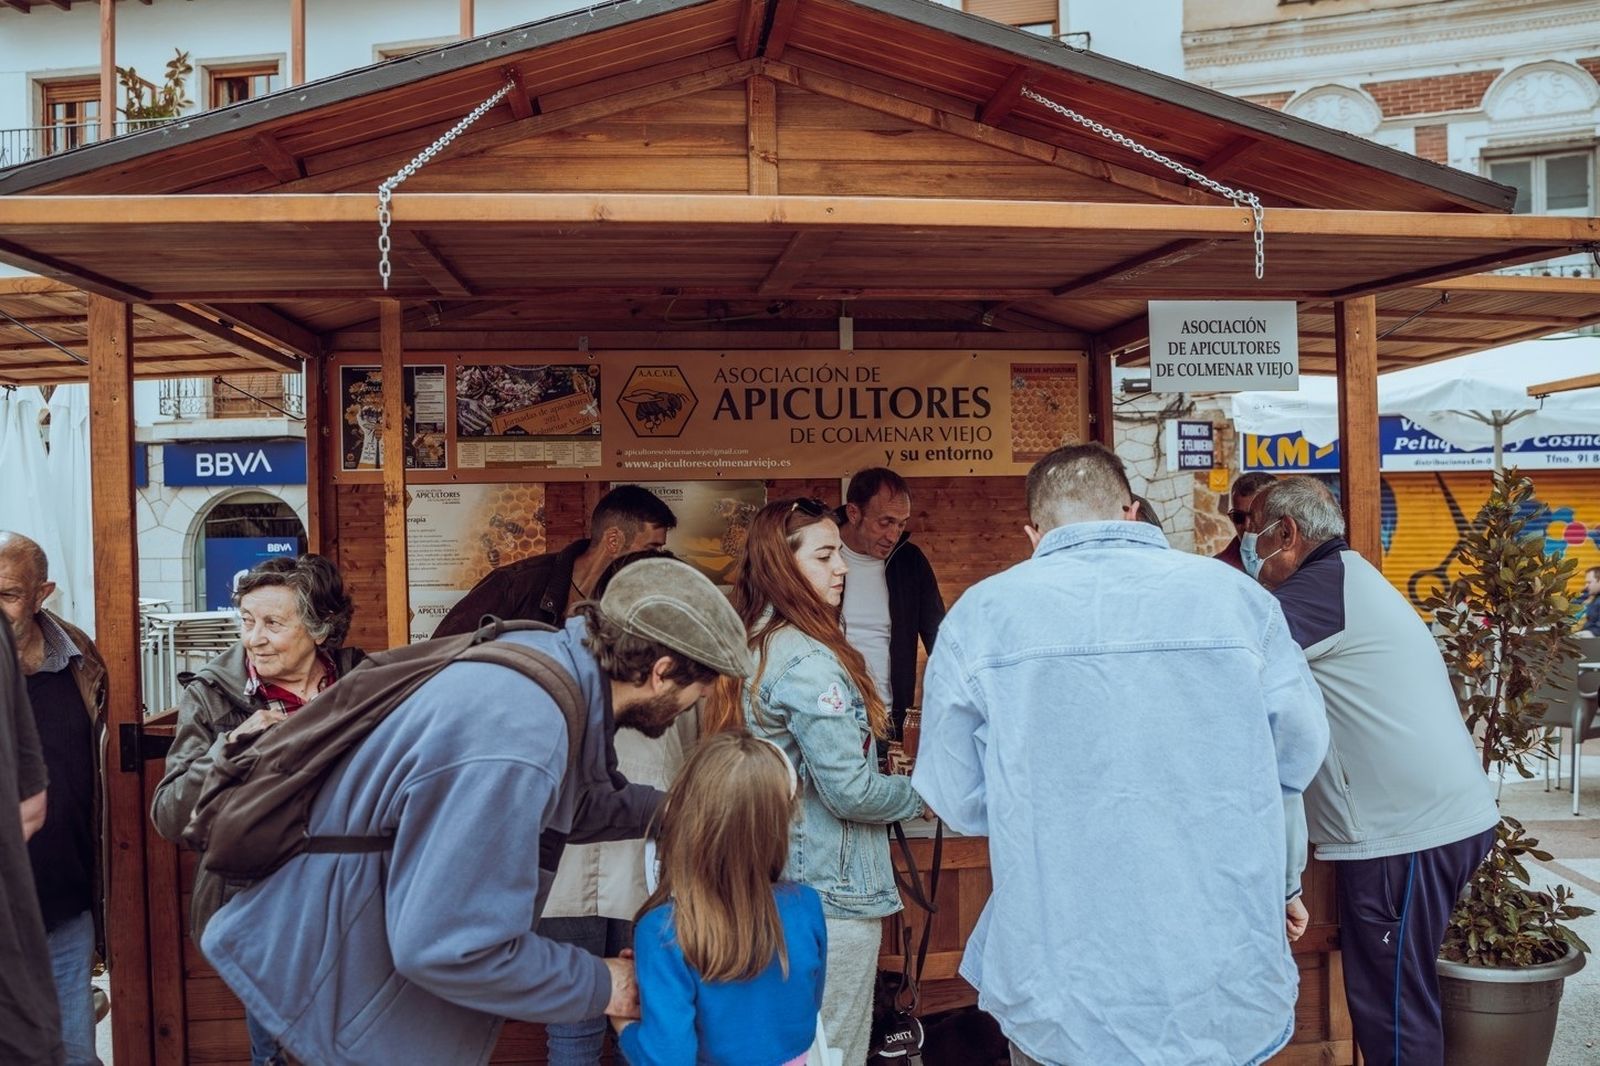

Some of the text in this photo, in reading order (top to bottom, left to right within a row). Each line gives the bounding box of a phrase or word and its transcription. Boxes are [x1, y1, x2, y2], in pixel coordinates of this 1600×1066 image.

[1181, 317, 1267, 334] ASOCIACIÓN
[1168, 341, 1281, 356] DE APICULTORES
[713, 363, 881, 384] ASOCIACIÓN DE
[1156, 361, 1294, 379] DE COLMENAR VIEJO
[712, 386, 992, 421] APICULTORES
[790, 425, 993, 444] DE COLMENAR VIEJO
[1394, 436, 1454, 453] Peluq
[196, 449, 272, 477] BBVA
[624, 457, 792, 471] www.apicultorescolmenarviejo.es
[885, 446, 993, 466] y su entorno
[415, 491, 461, 499] APICULTORES
[267, 543, 292, 553] BBVA
[885, 1030, 913, 1044] CURITY
